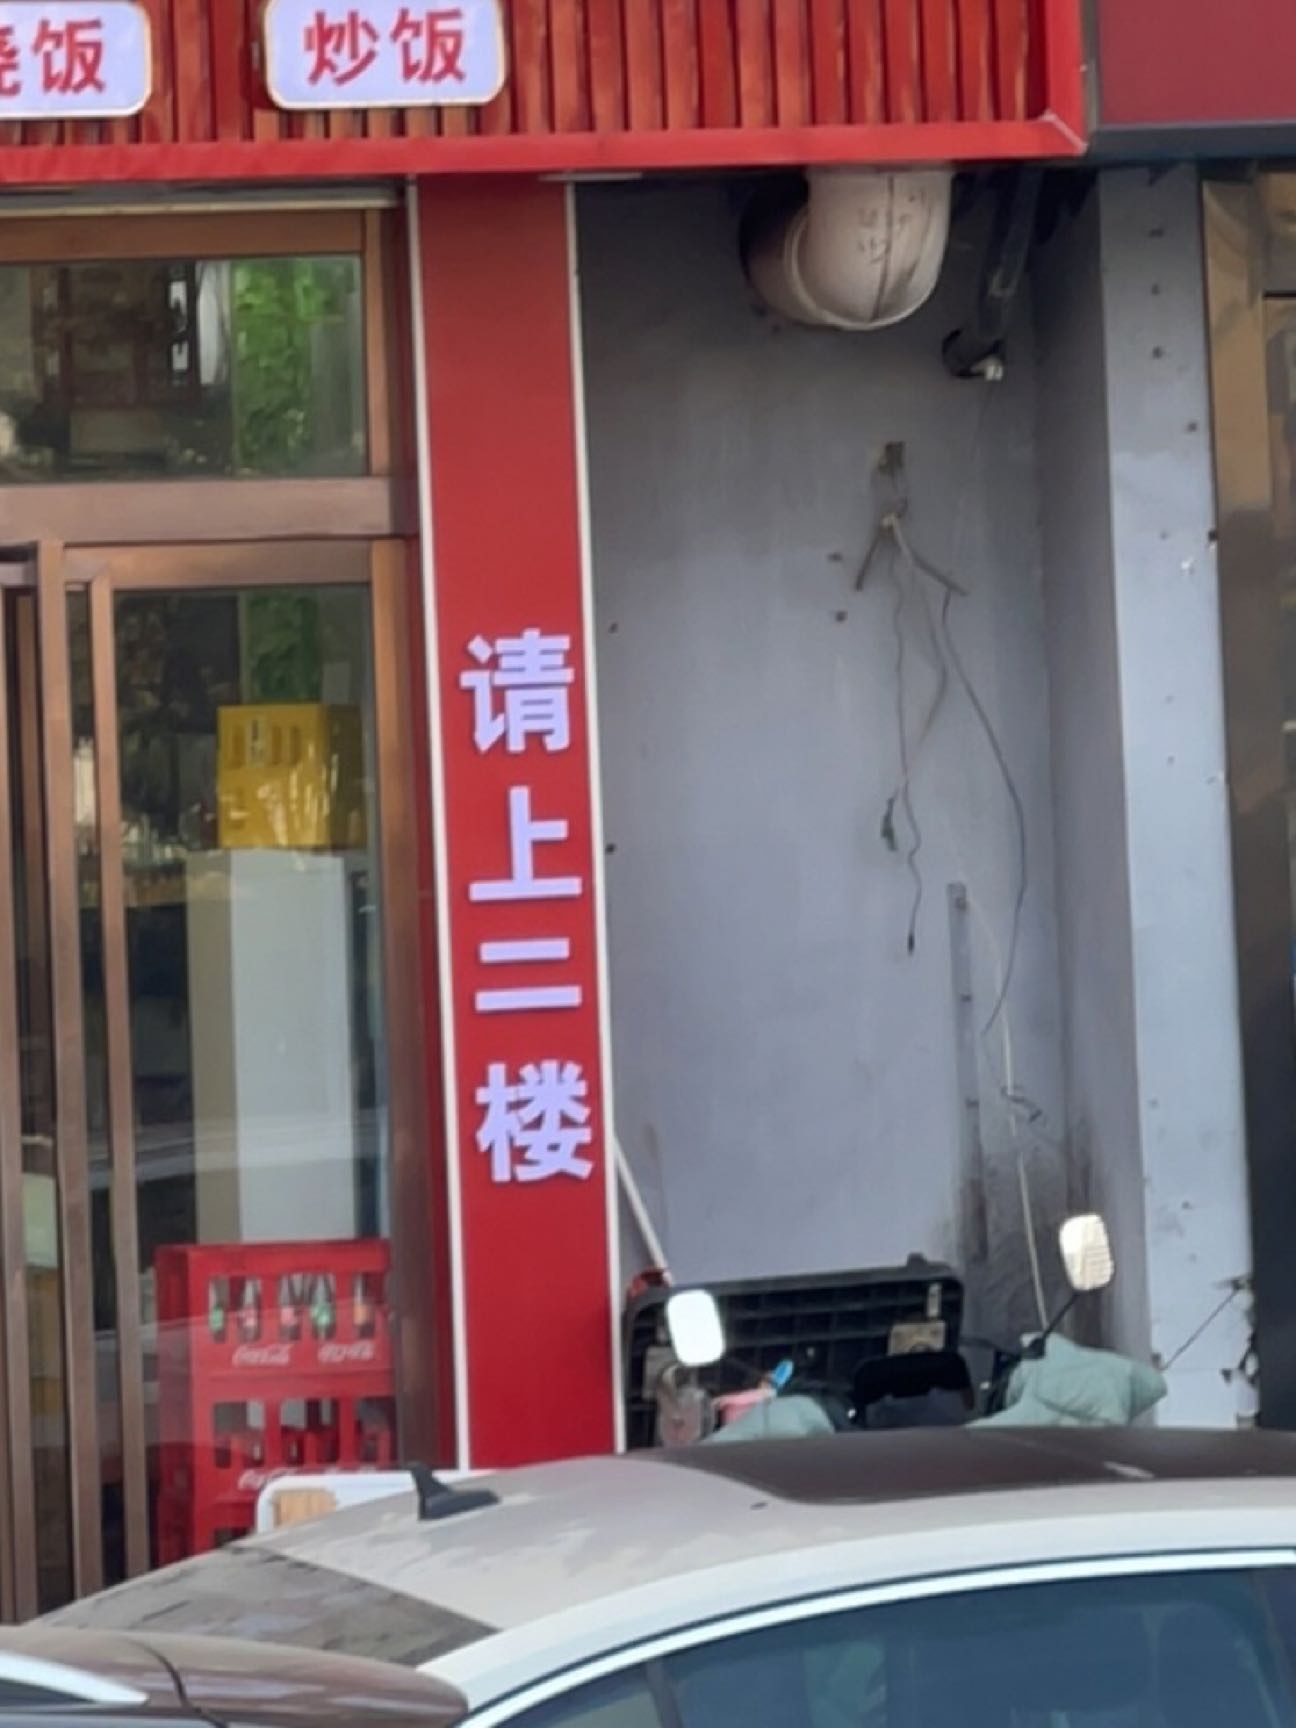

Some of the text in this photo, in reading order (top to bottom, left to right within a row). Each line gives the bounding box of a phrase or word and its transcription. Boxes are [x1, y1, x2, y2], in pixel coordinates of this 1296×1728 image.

[302, 8, 467, 87] 炒饭
[459, 628, 593, 1184] 请上二楼
